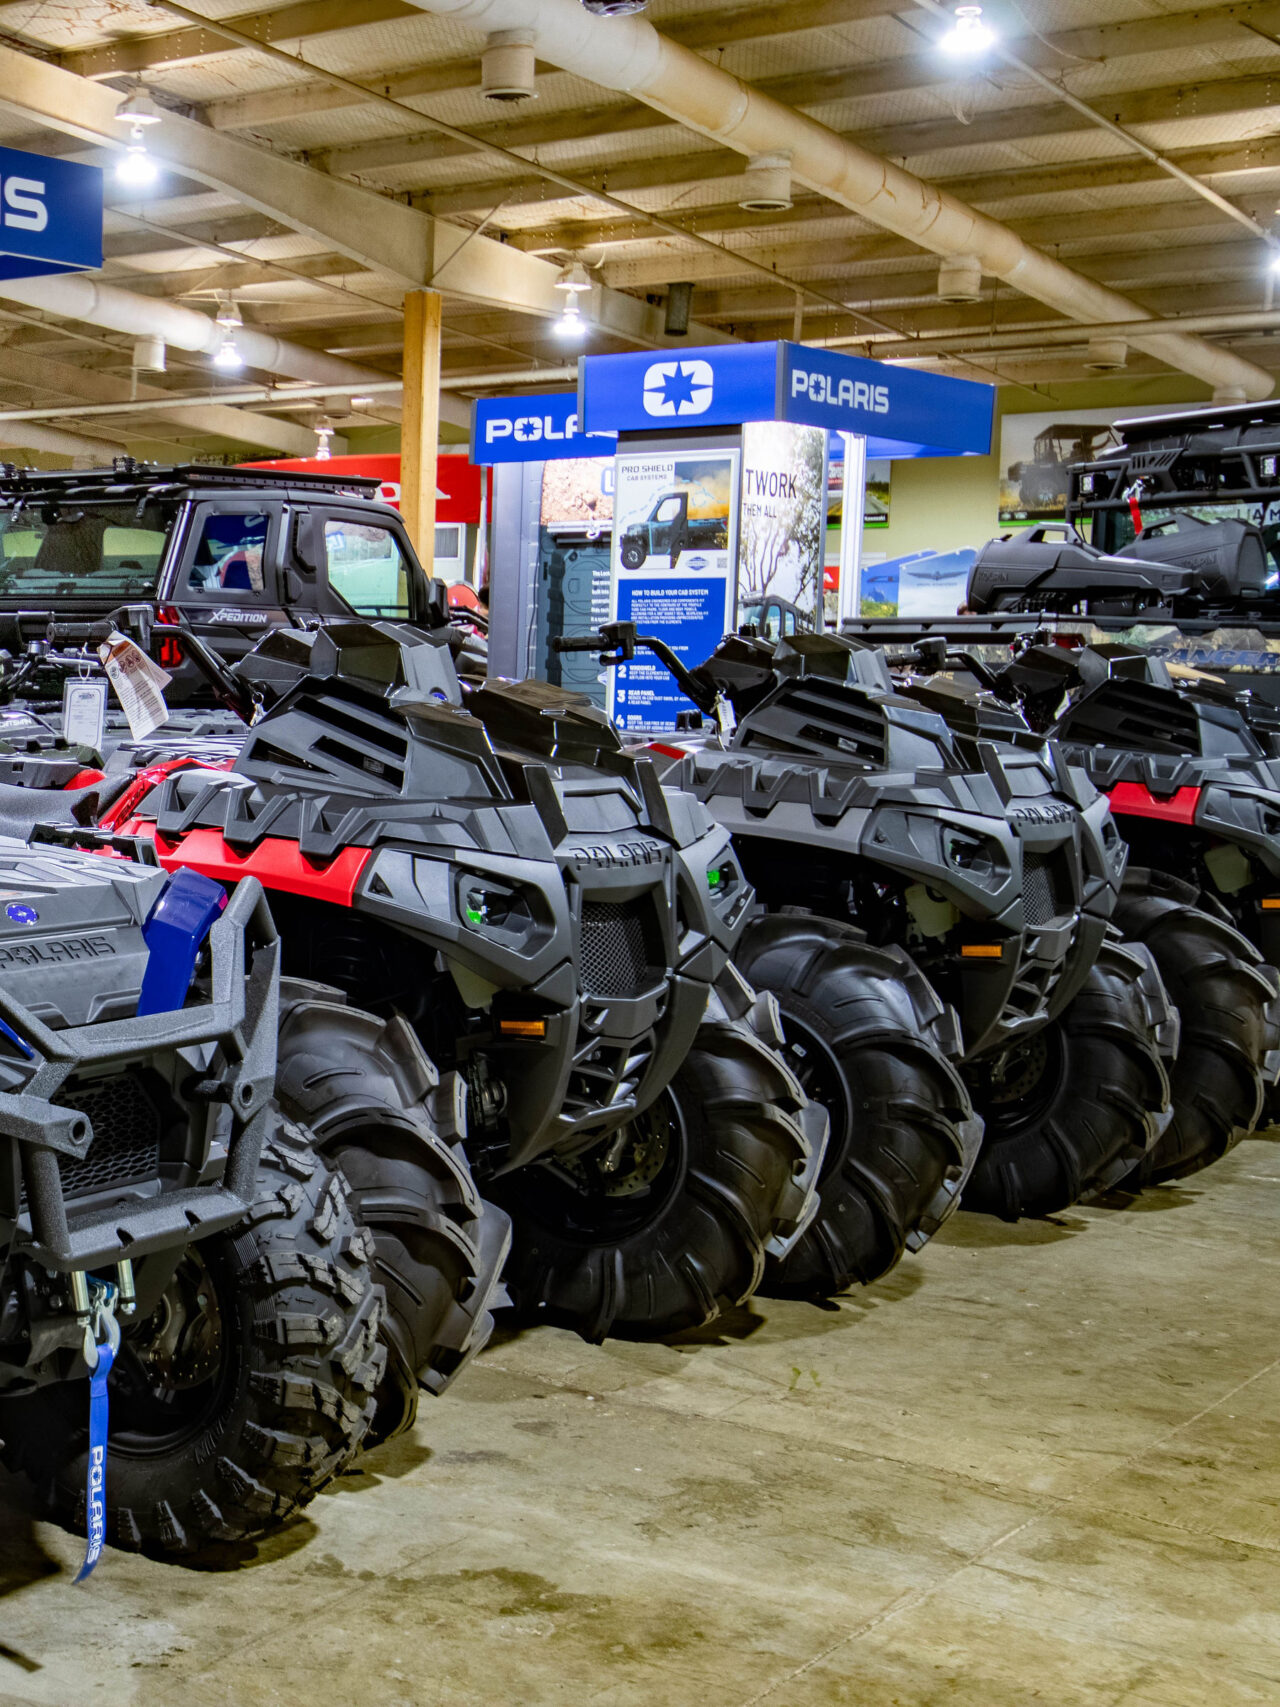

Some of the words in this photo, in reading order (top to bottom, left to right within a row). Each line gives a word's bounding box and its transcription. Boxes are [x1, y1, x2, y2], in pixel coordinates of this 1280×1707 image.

[792, 369, 889, 414] POLARIS
[622, 466, 640, 474] PRO
[642, 464, 673, 473] SHIELD
[745, 468, 798, 499] TWORK
[743, 503, 761, 517] THEM
[764, 504, 777, 518] ALL
[207, 608, 267, 624] XPEDITION
[617, 665, 627, 678] 2
[617, 690, 625, 703] 3
[616, 714, 625, 728] 4
[568, 840, 662, 871] POLARIS
[86, 1444, 104, 1564] POLARIS
